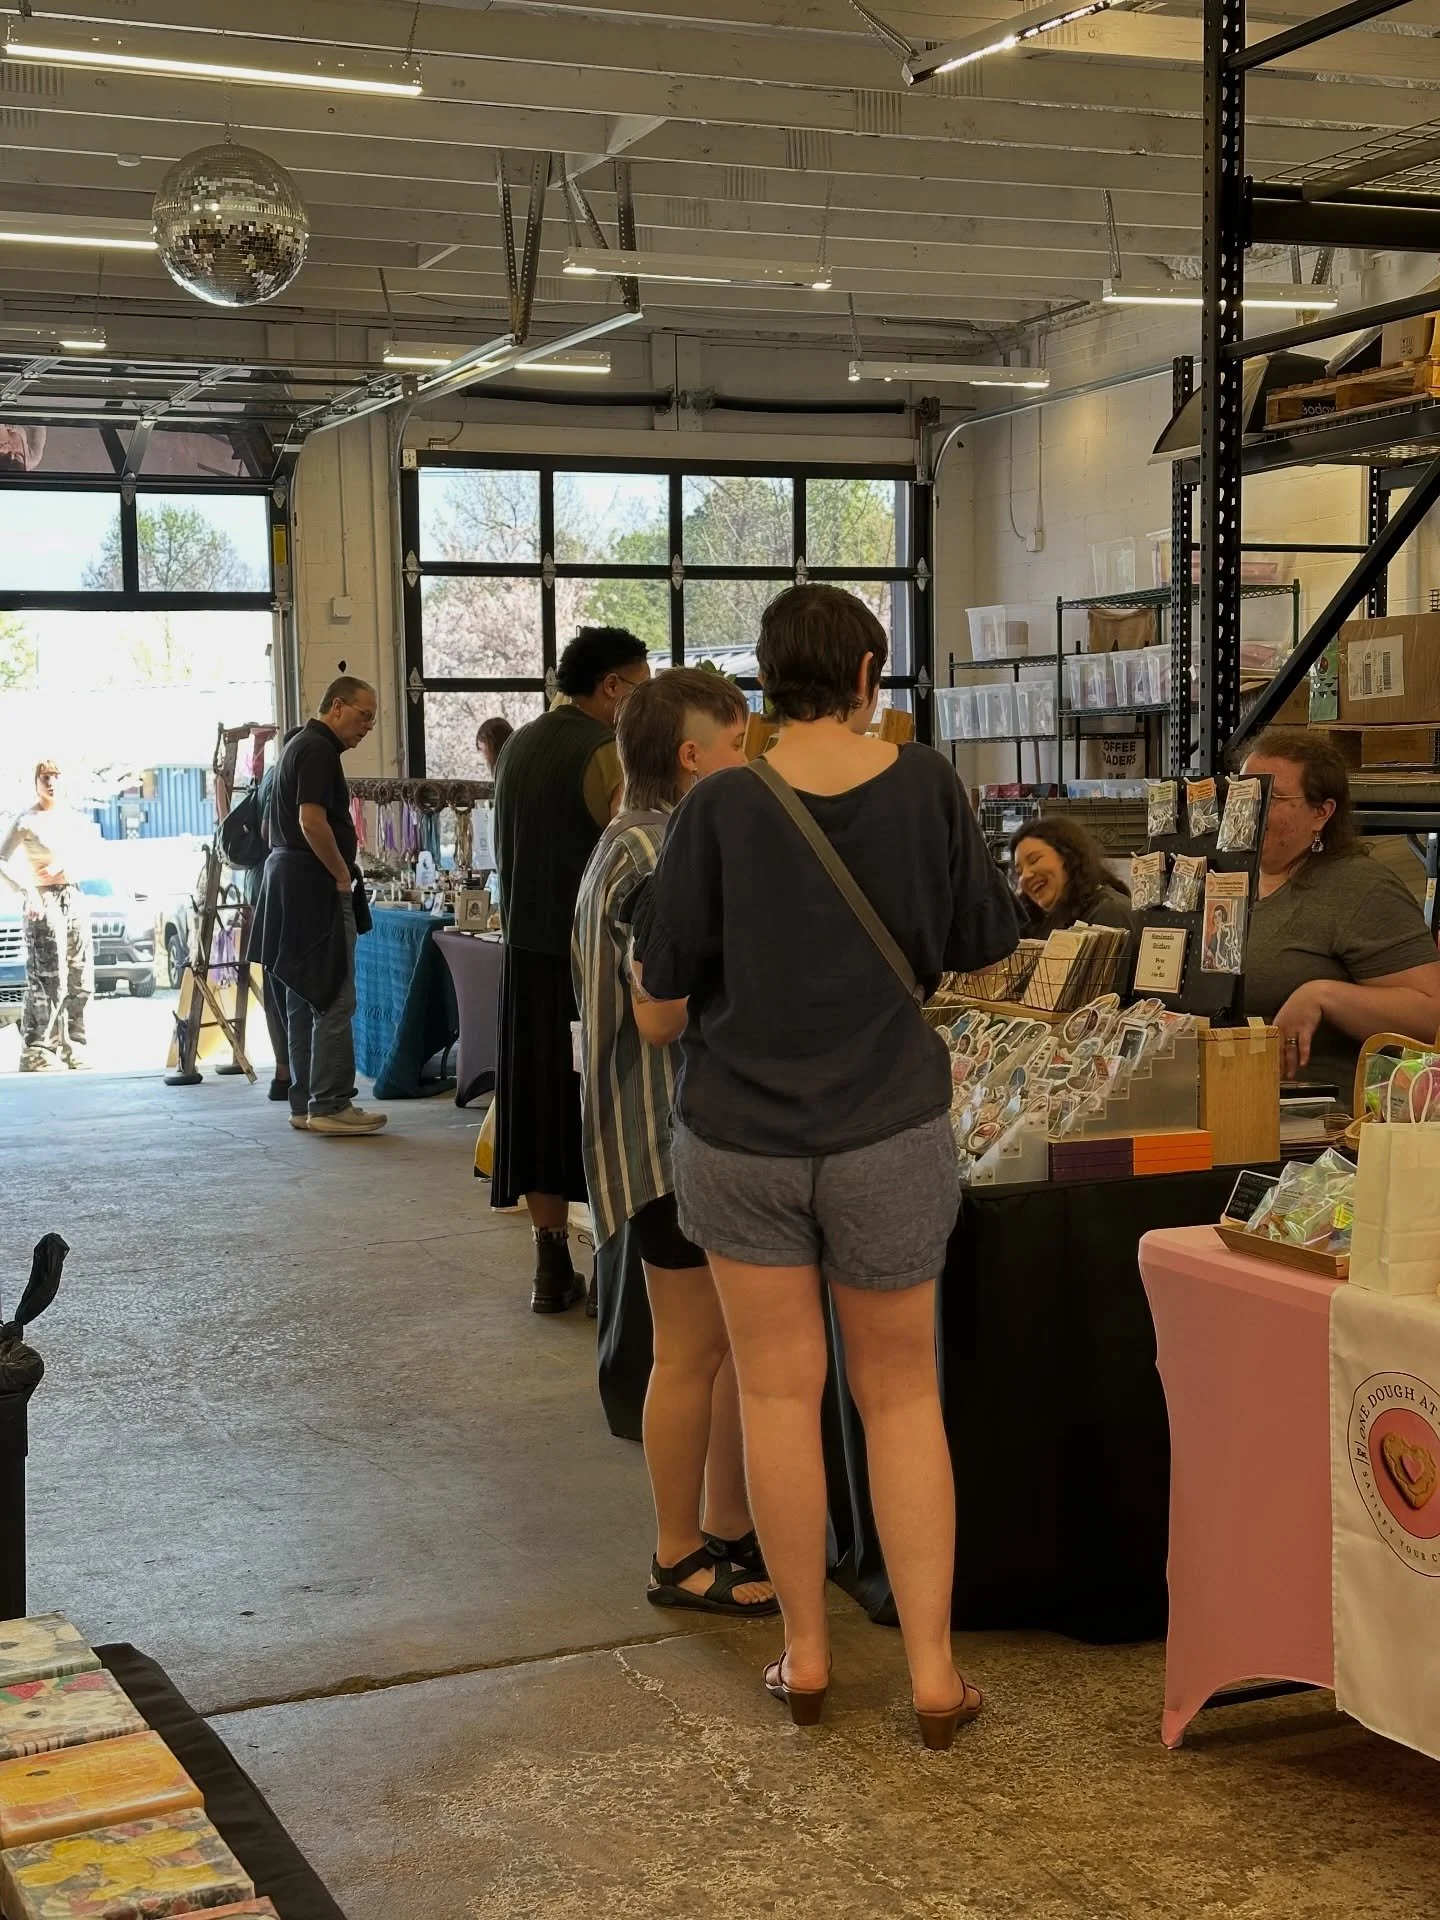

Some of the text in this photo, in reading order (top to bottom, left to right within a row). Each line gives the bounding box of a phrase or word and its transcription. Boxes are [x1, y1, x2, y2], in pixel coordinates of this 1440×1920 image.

[1103, 741, 1136, 752] OFFEE
[1359, 1384, 1438, 1440] ONE DOUGH AT
[1400, 1539, 1426, 1560] YOUR
